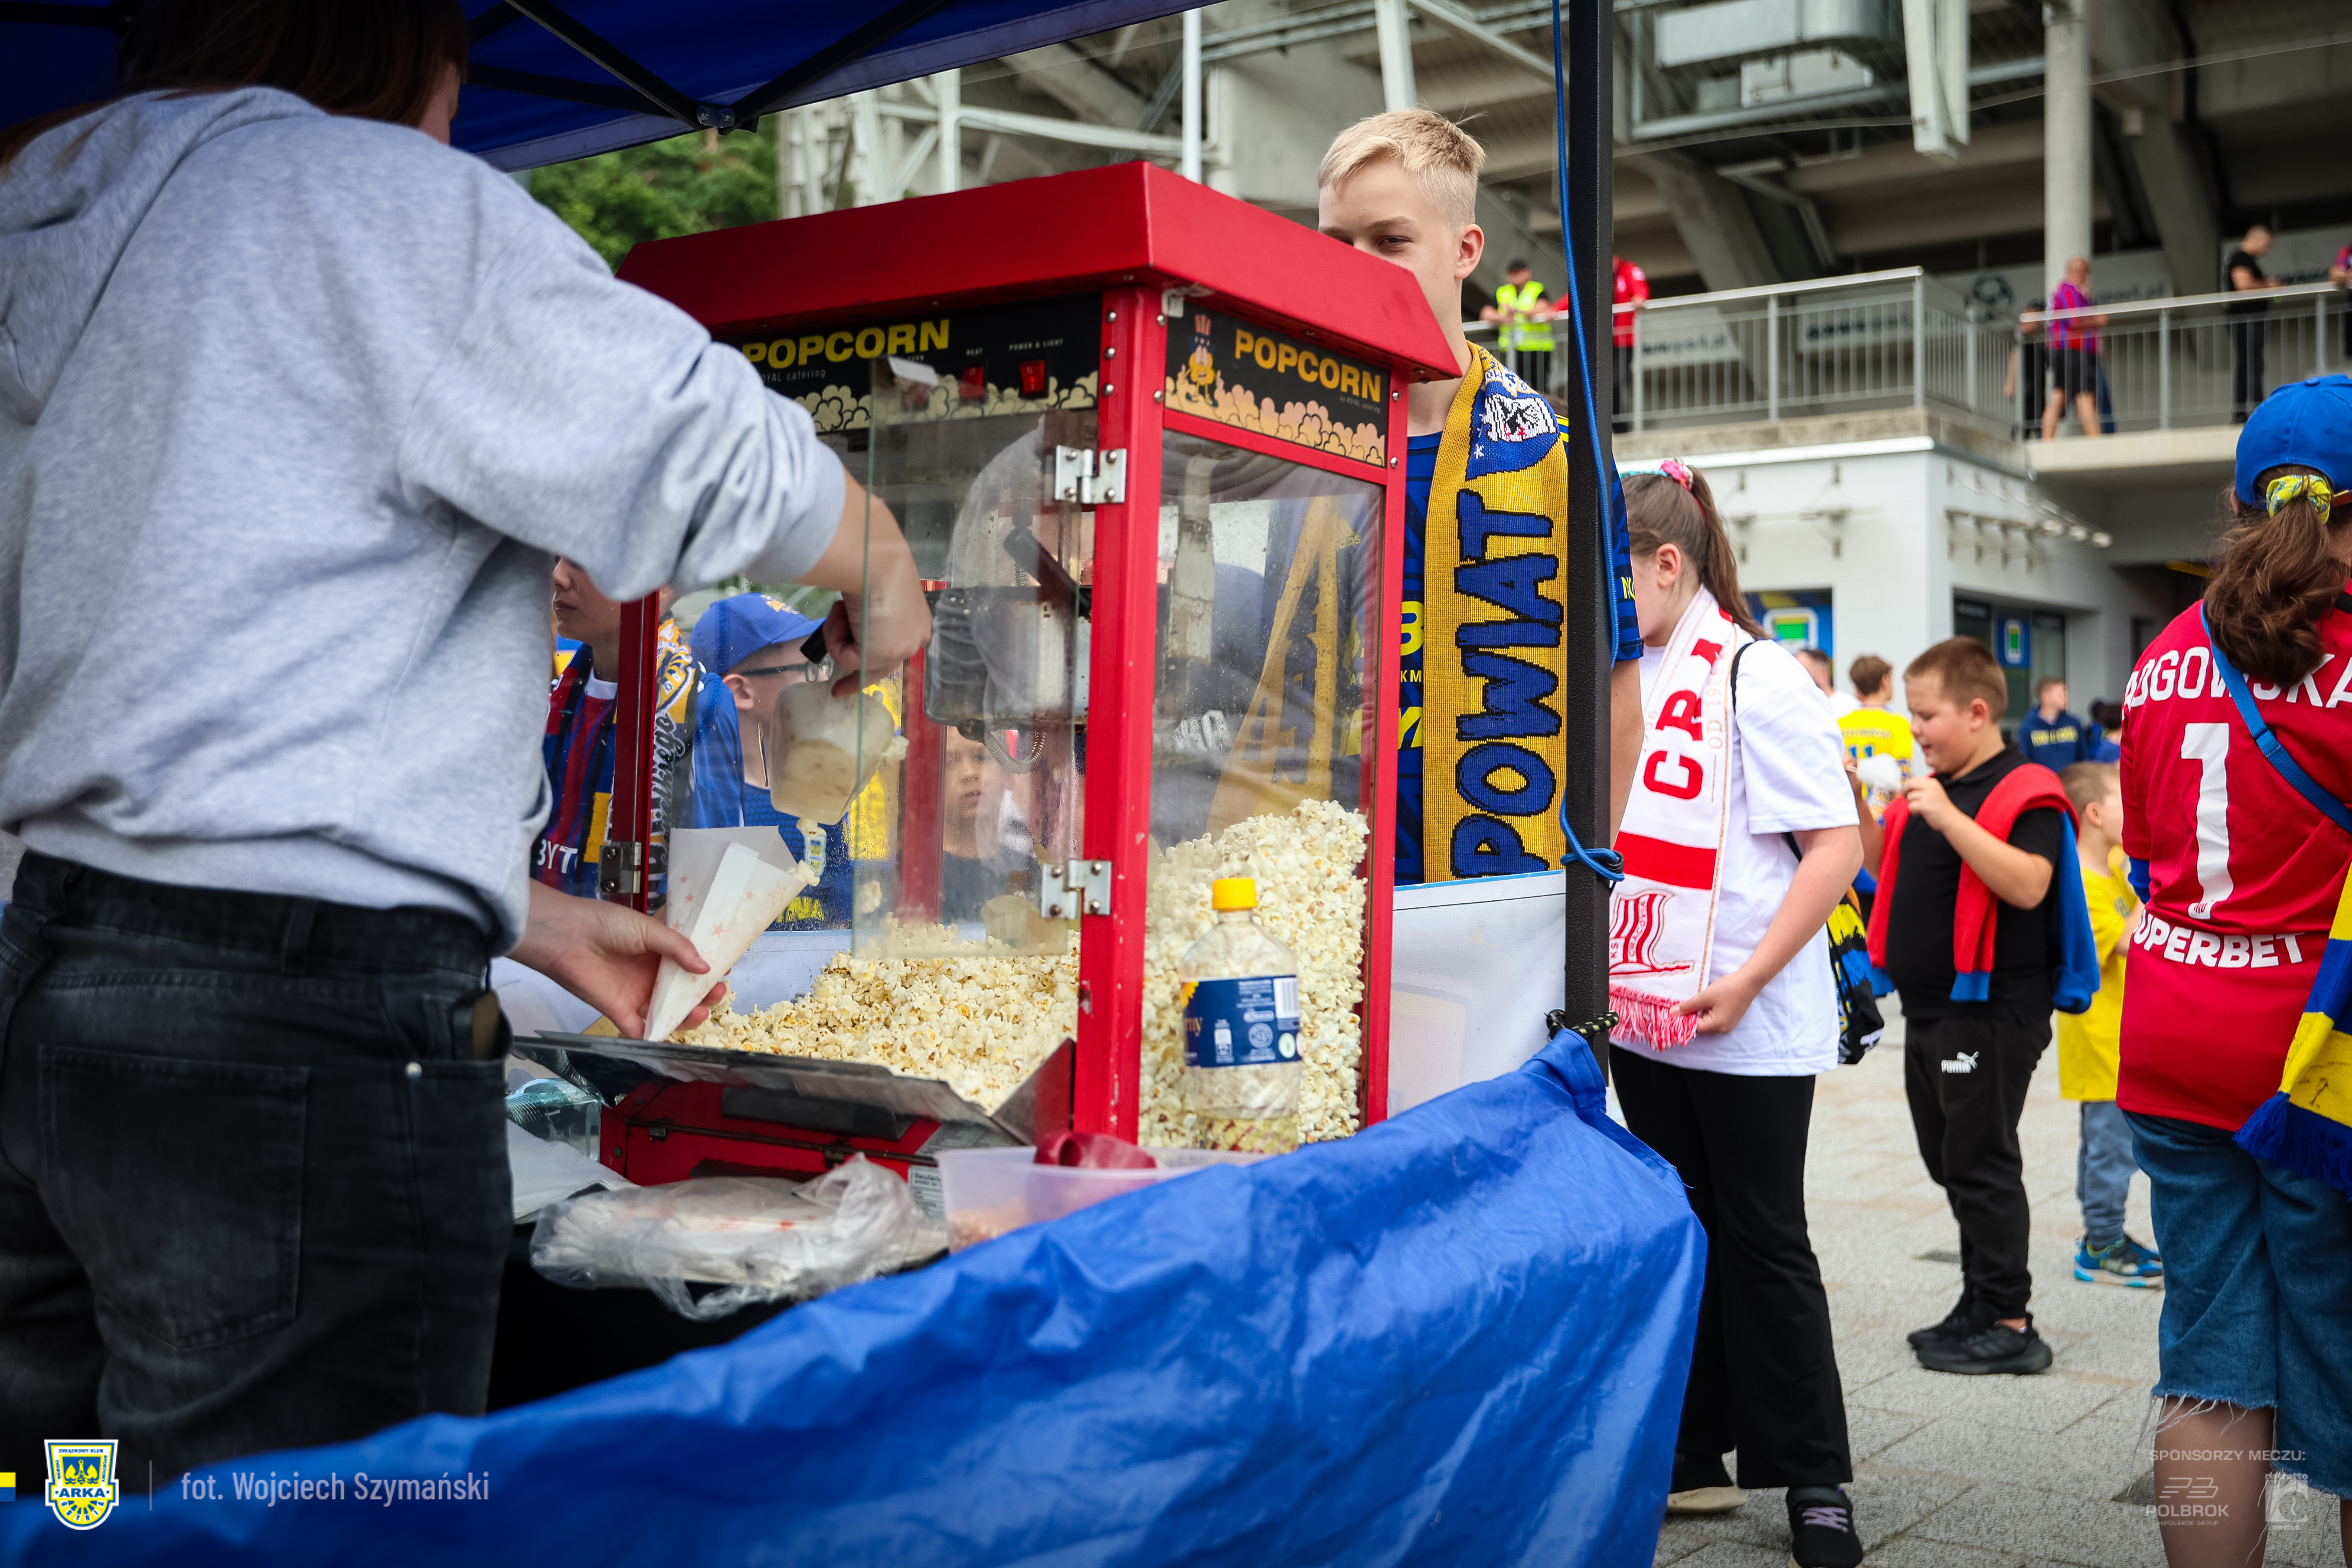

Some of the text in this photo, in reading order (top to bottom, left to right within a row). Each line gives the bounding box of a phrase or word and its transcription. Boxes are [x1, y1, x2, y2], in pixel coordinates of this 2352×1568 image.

[742, 319, 949, 369] POPCORN
[760, 368, 826, 384] OYAL catering
[1234, 328, 1381, 403] POPCORN
[1451, 488, 1563, 879] POWIAT
[2181, 722, 2234, 920] 1
[2132, 913, 2305, 968] UPERBET
